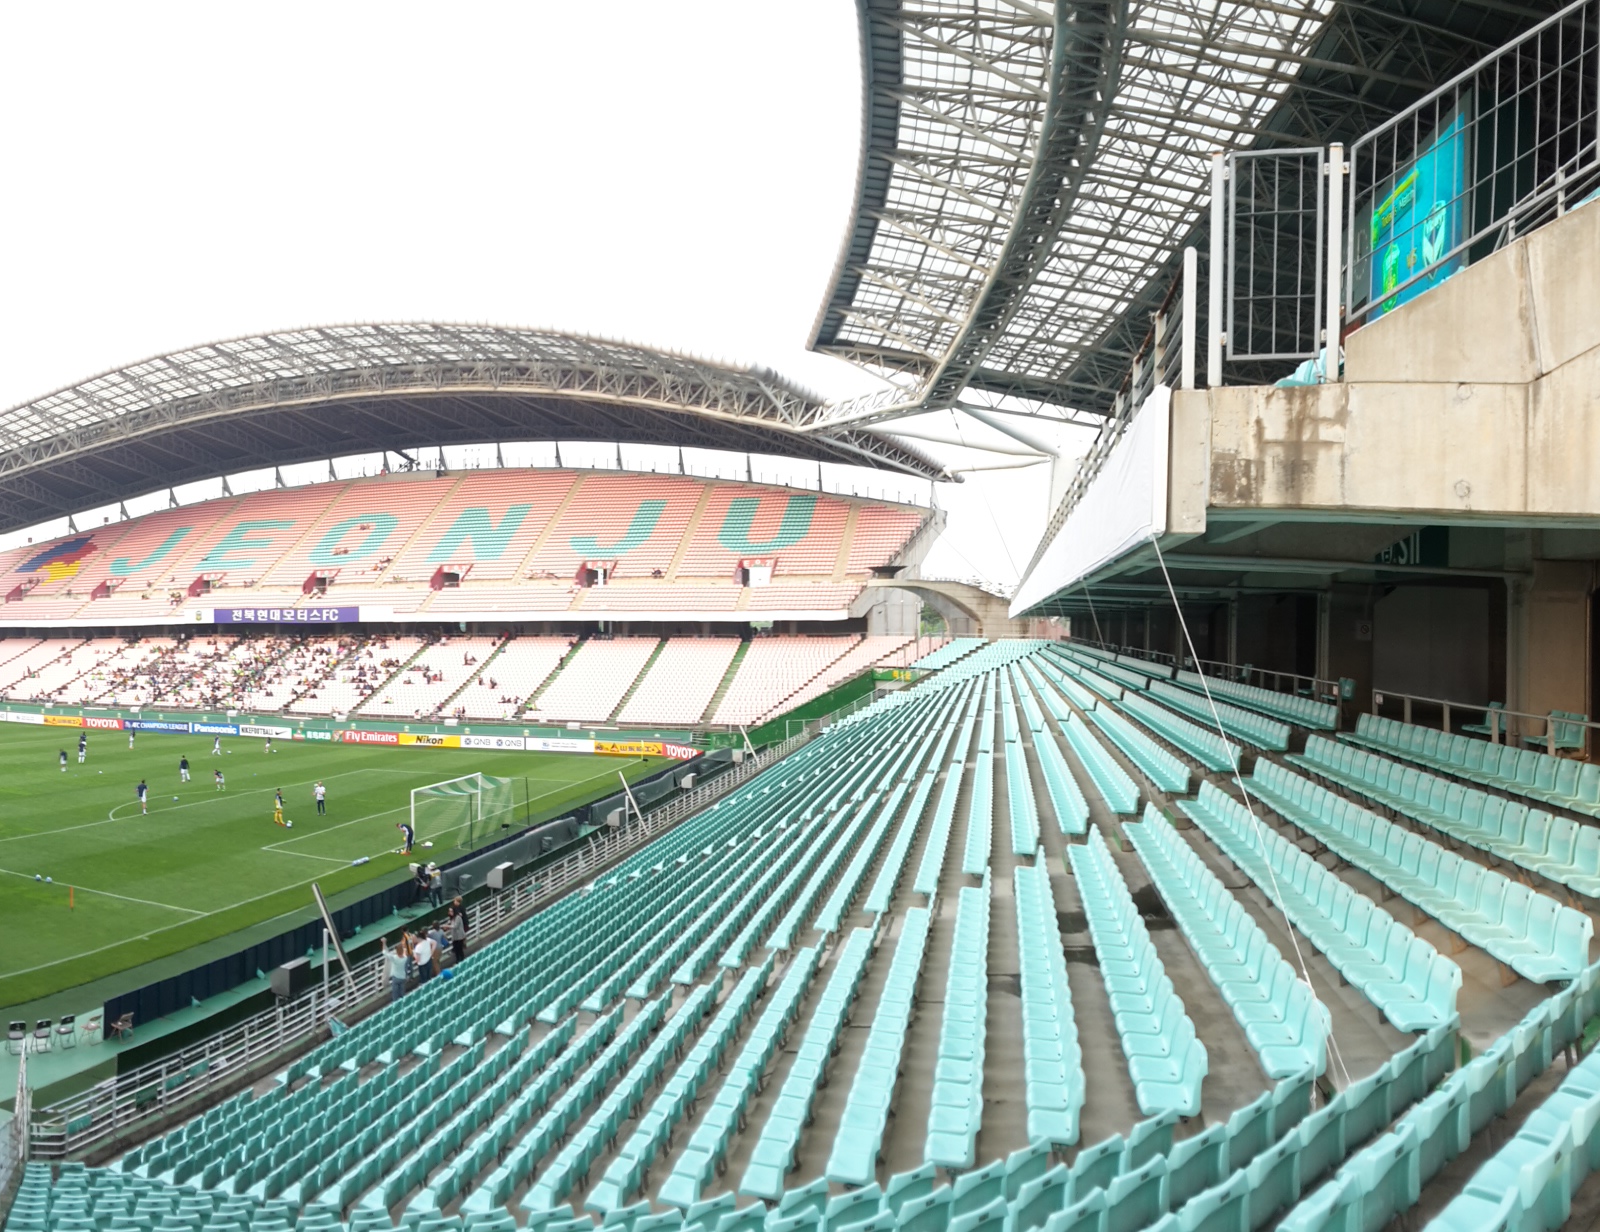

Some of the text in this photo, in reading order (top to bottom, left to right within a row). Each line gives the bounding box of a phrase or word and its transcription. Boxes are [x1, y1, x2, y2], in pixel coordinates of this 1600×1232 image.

[110, 495, 818, 576] JEONJU
[232, 609, 339, 621] 전북현대모터스FC
[86, 718, 119, 729] TOYOTA
[141, 722, 168, 730] CHAMPIONS
[169, 723, 188, 731] LEAGUE
[194, 723, 237, 735] Panasonic
[345, 731, 397, 743] Fly Emirates
[416, 735, 444, 745] Nikon
[474, 738, 491, 747] QNB
[505, 740, 522, 748] QNB
[666, 744, 698, 759] TOYOTA
